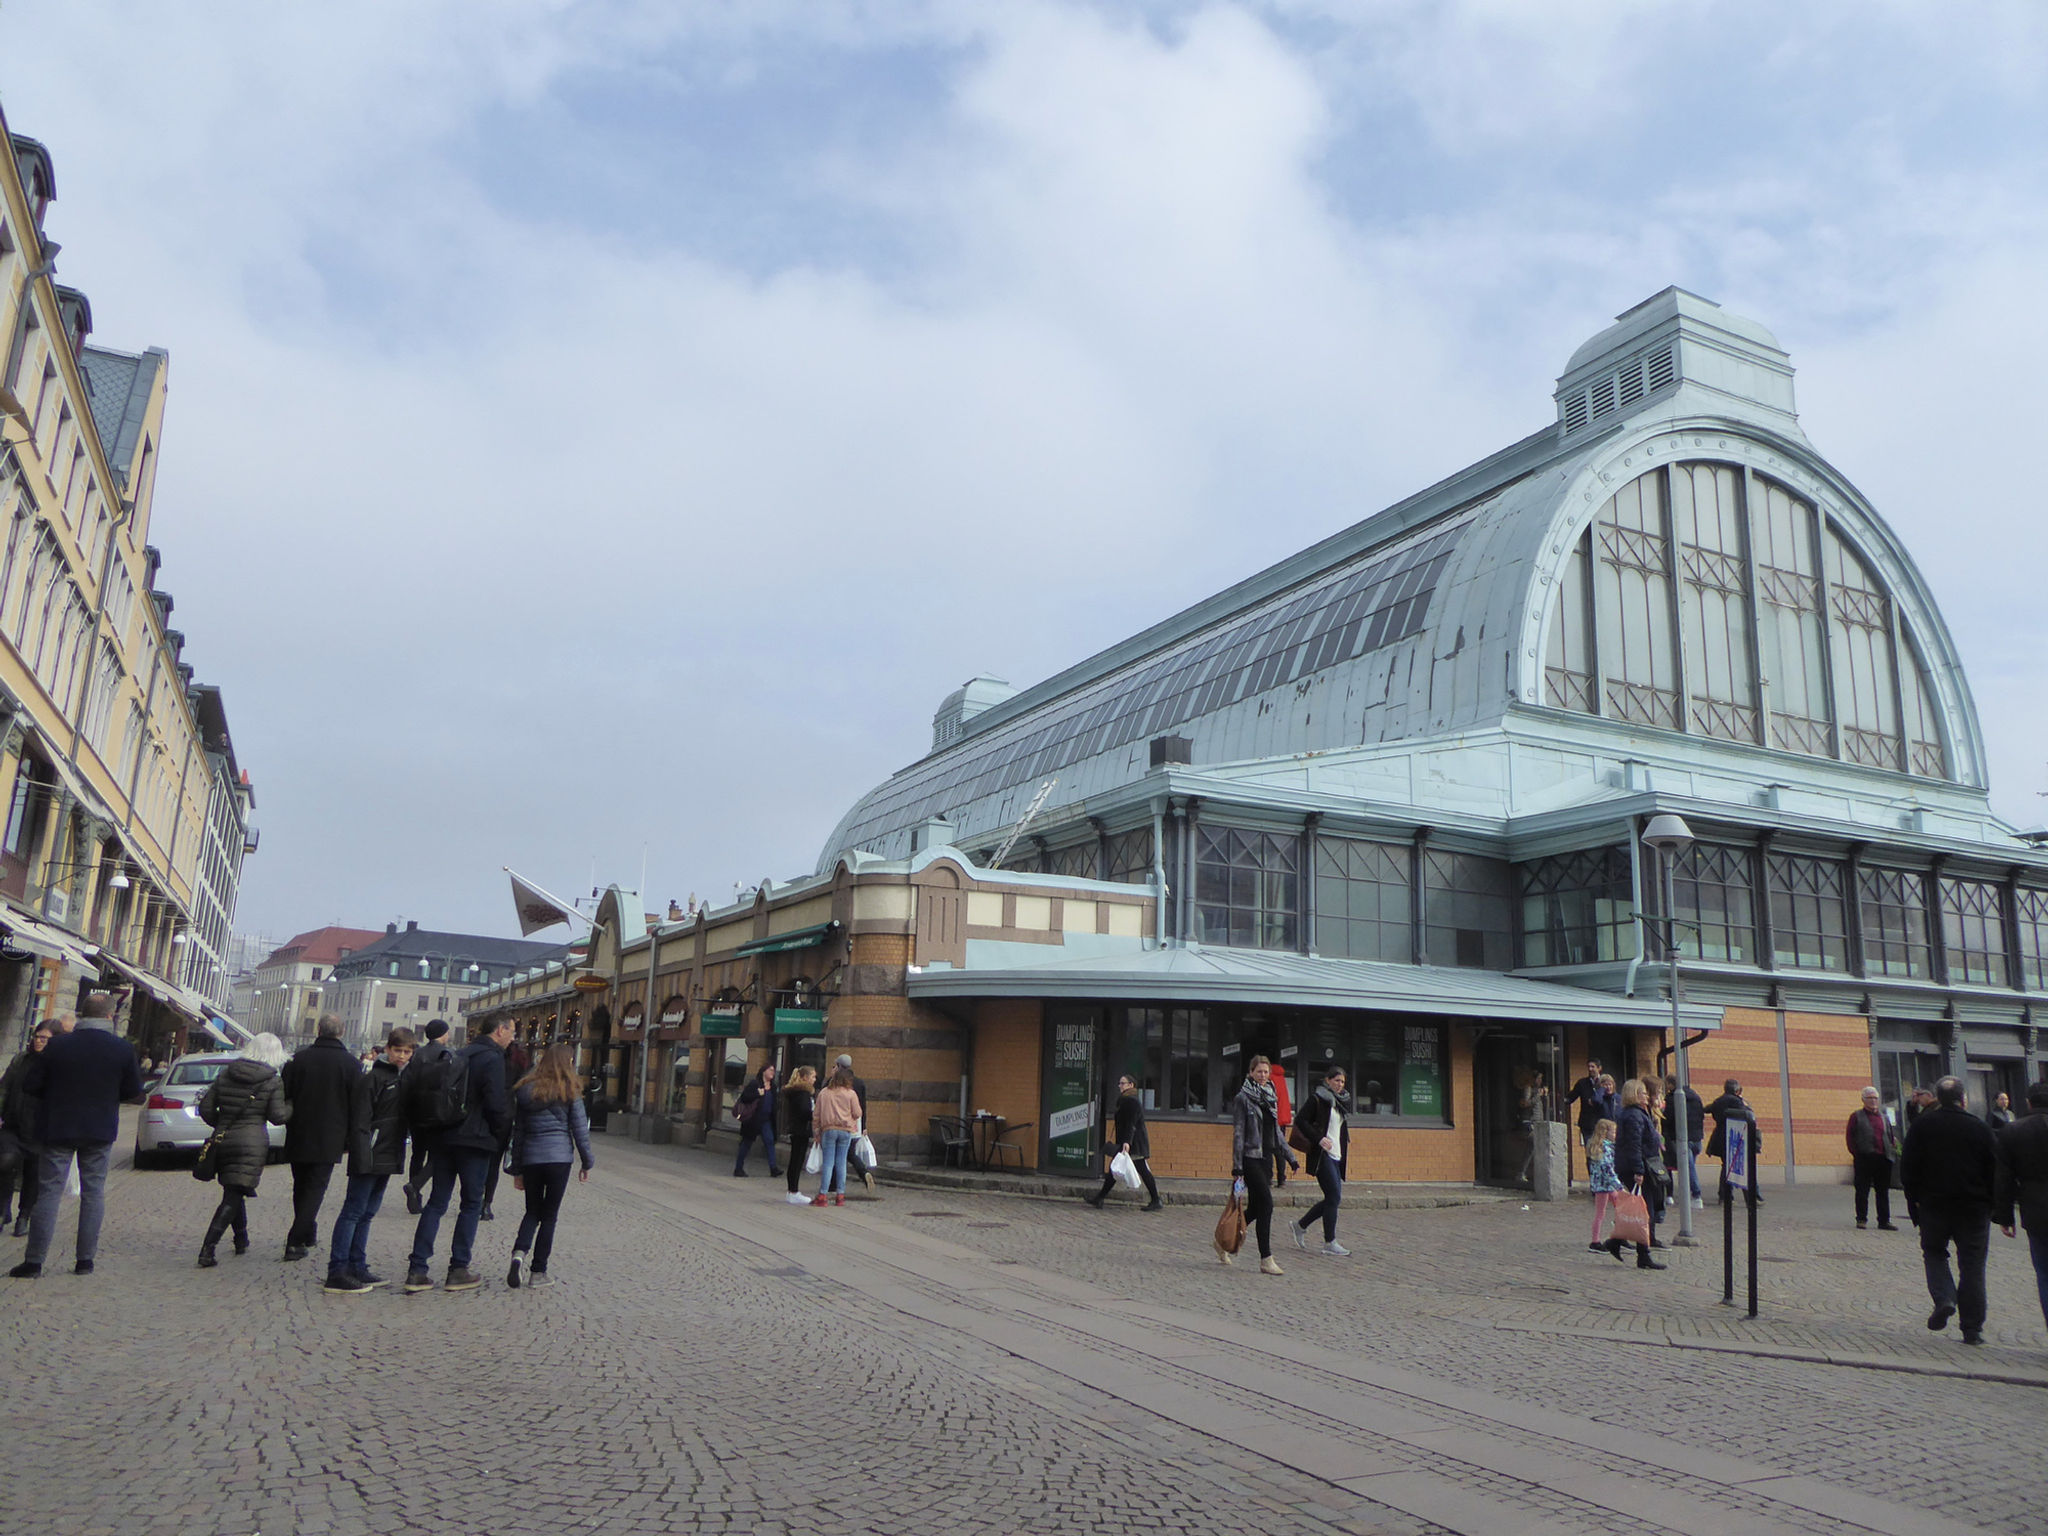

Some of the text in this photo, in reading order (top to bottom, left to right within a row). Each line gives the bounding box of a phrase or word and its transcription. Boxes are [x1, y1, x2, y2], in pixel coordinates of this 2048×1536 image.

[1063, 1041, 1087, 1061] SUSHI
[1412, 1041, 1432, 1059] SUSHI
[1055, 1108, 1089, 1127] DUMPLINGS
